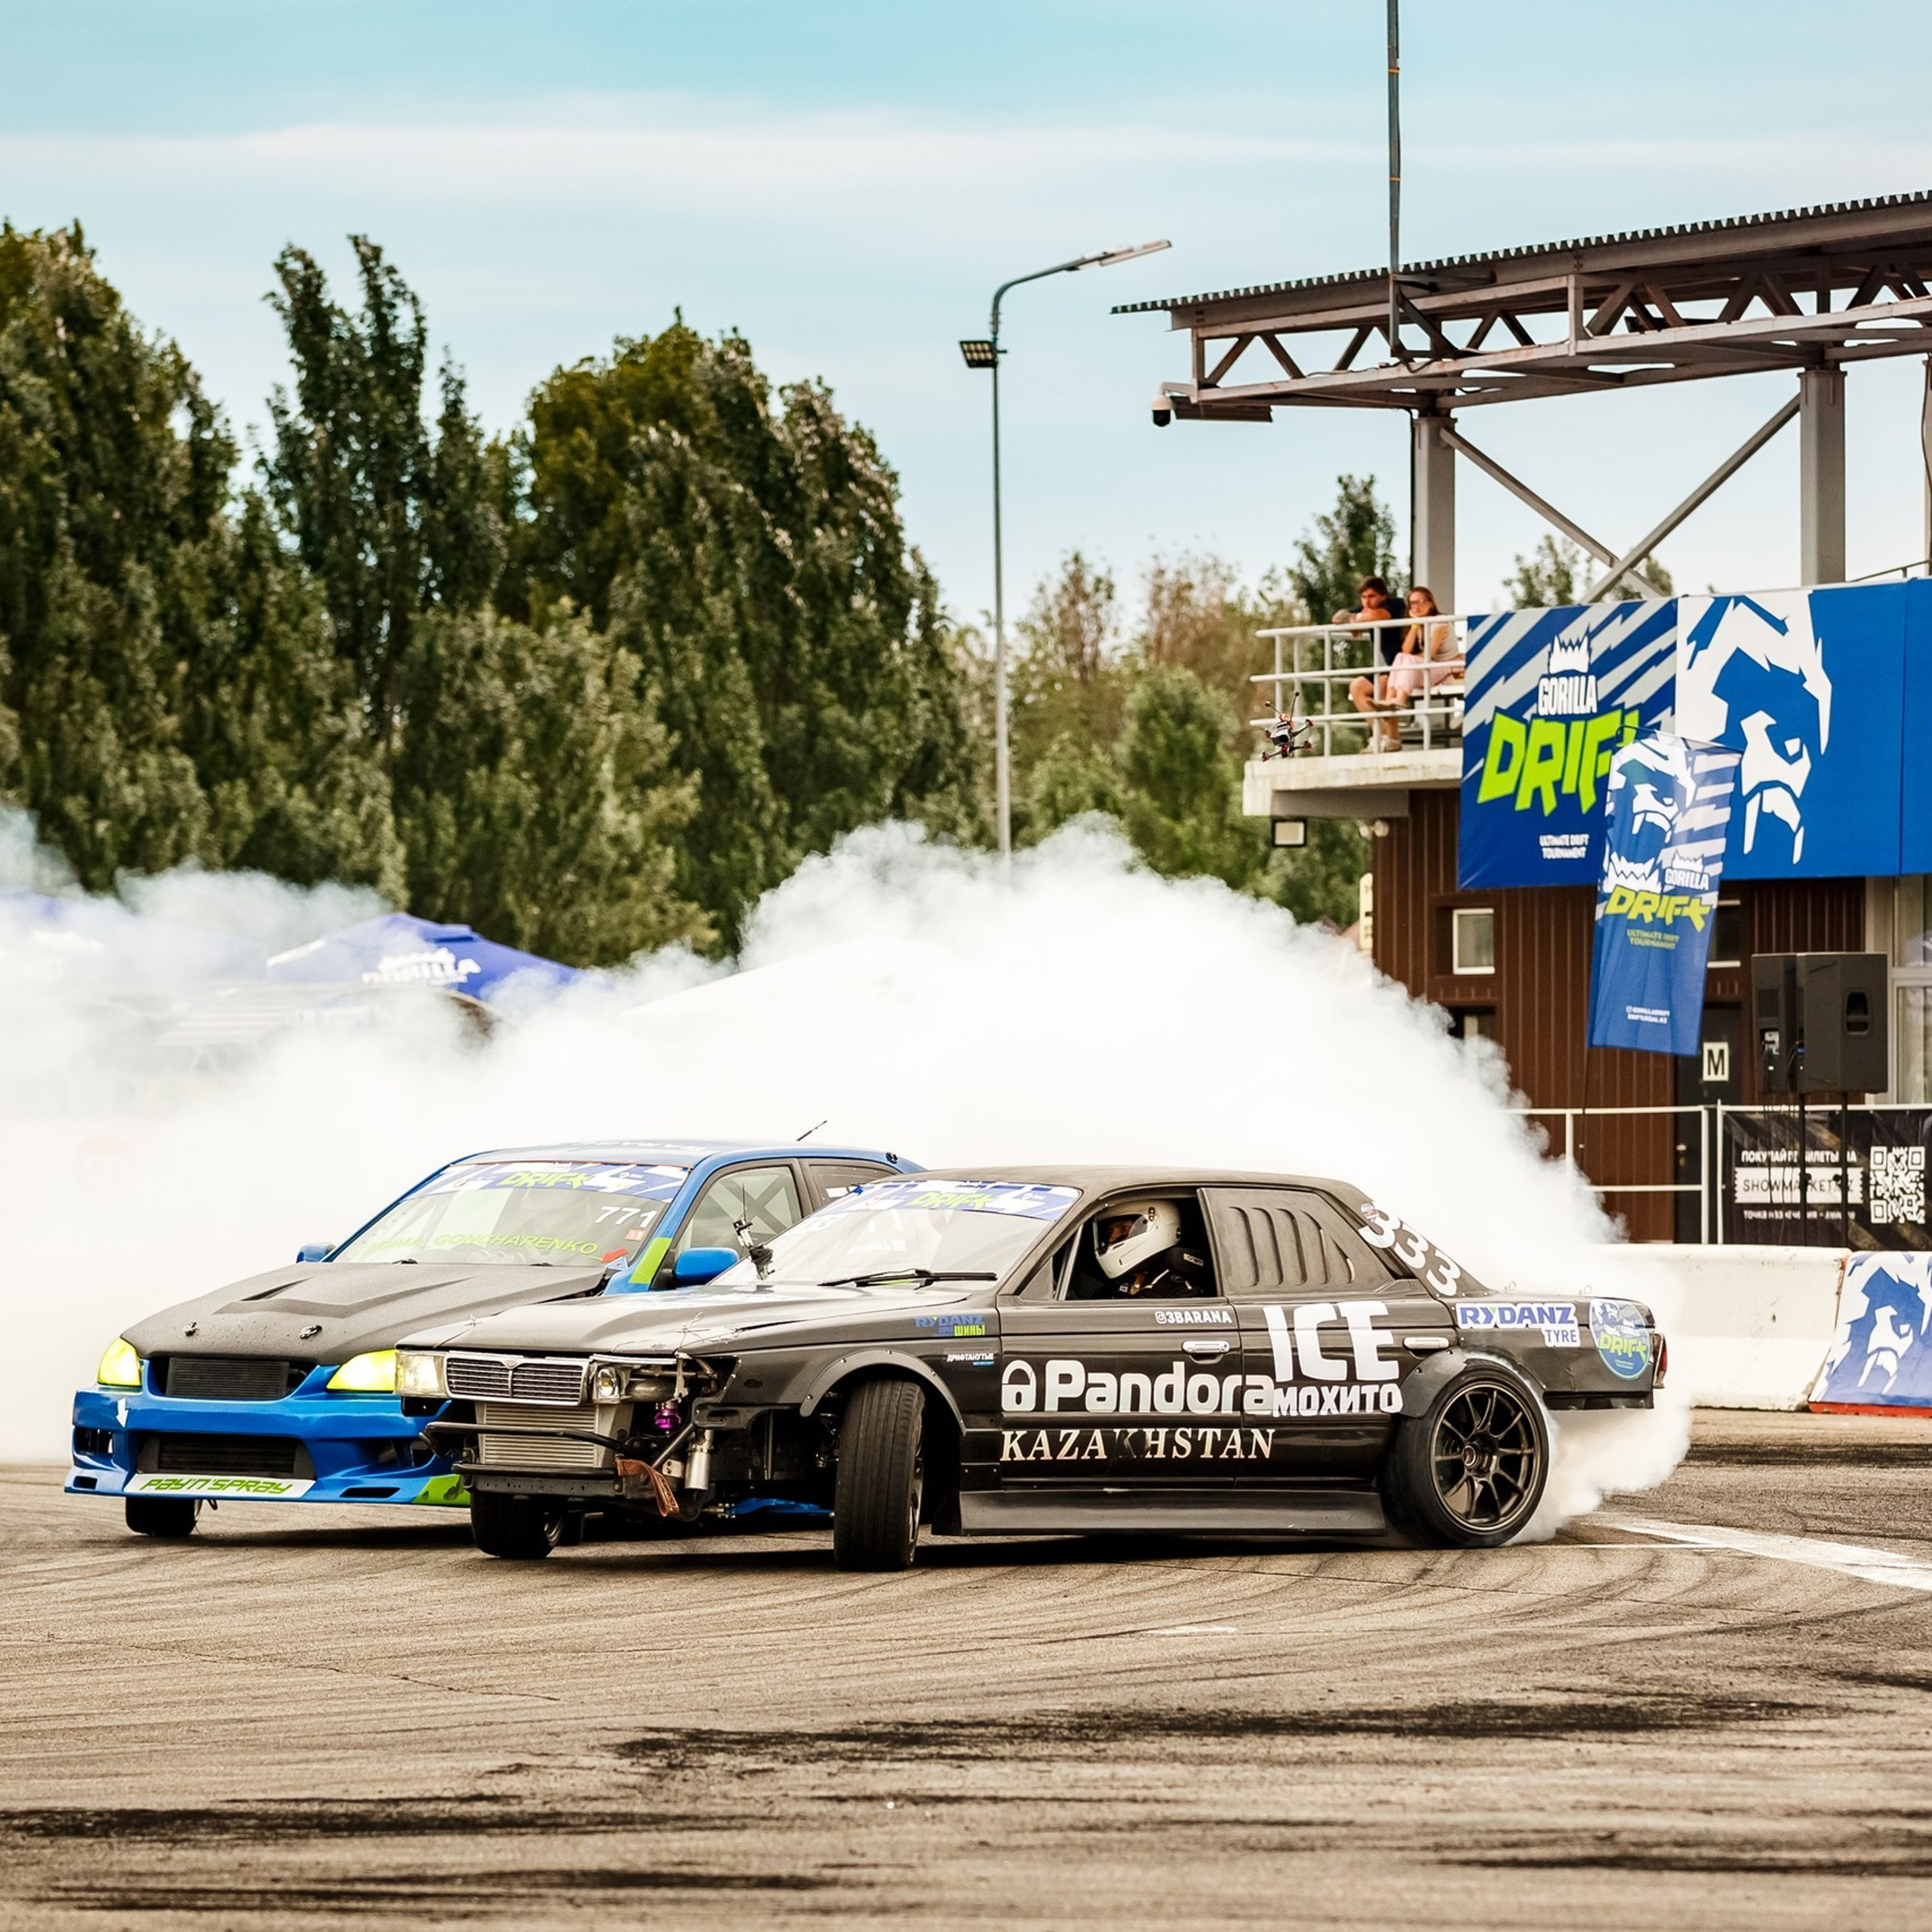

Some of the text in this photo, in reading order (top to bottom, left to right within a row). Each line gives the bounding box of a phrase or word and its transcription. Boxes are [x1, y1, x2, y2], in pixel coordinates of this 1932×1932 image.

[1538, 675, 1598, 715] GORILLA
[1477, 709, 1639, 817] DRIF
[1665, 868, 1709, 891] GORILLA
[1604, 884, 1710, 933] DRIFT
[1708, 1049, 1724, 1076] M
[1805, 1150, 1839, 1163] ИЛЕТЫ
[497, 1172, 595, 1189] DRIFT
[905, 1192, 996, 1210] DRIFT
[595, 1206, 658, 1229] 771
[432, 1233, 598, 1254] GONCHARENKO
[1358, 1201, 1461, 1297] 333
[915, 1314, 984, 1327] RYDANZ
[1460, 1306, 1575, 1324] RYDANZ
[954, 1324, 985, 1337] ШИНЫ
[1263, 1300, 1400, 1383] ICE
[1546, 1329, 1577, 1343] TYRE
[1599, 1331, 1647, 1364] DRIFT
[1044, 1359, 1274, 1414] Pandora
[1272, 1383, 1404, 1418] МОХИТО
[1000, 1426, 1275, 1461] KAZAKHSTAN
